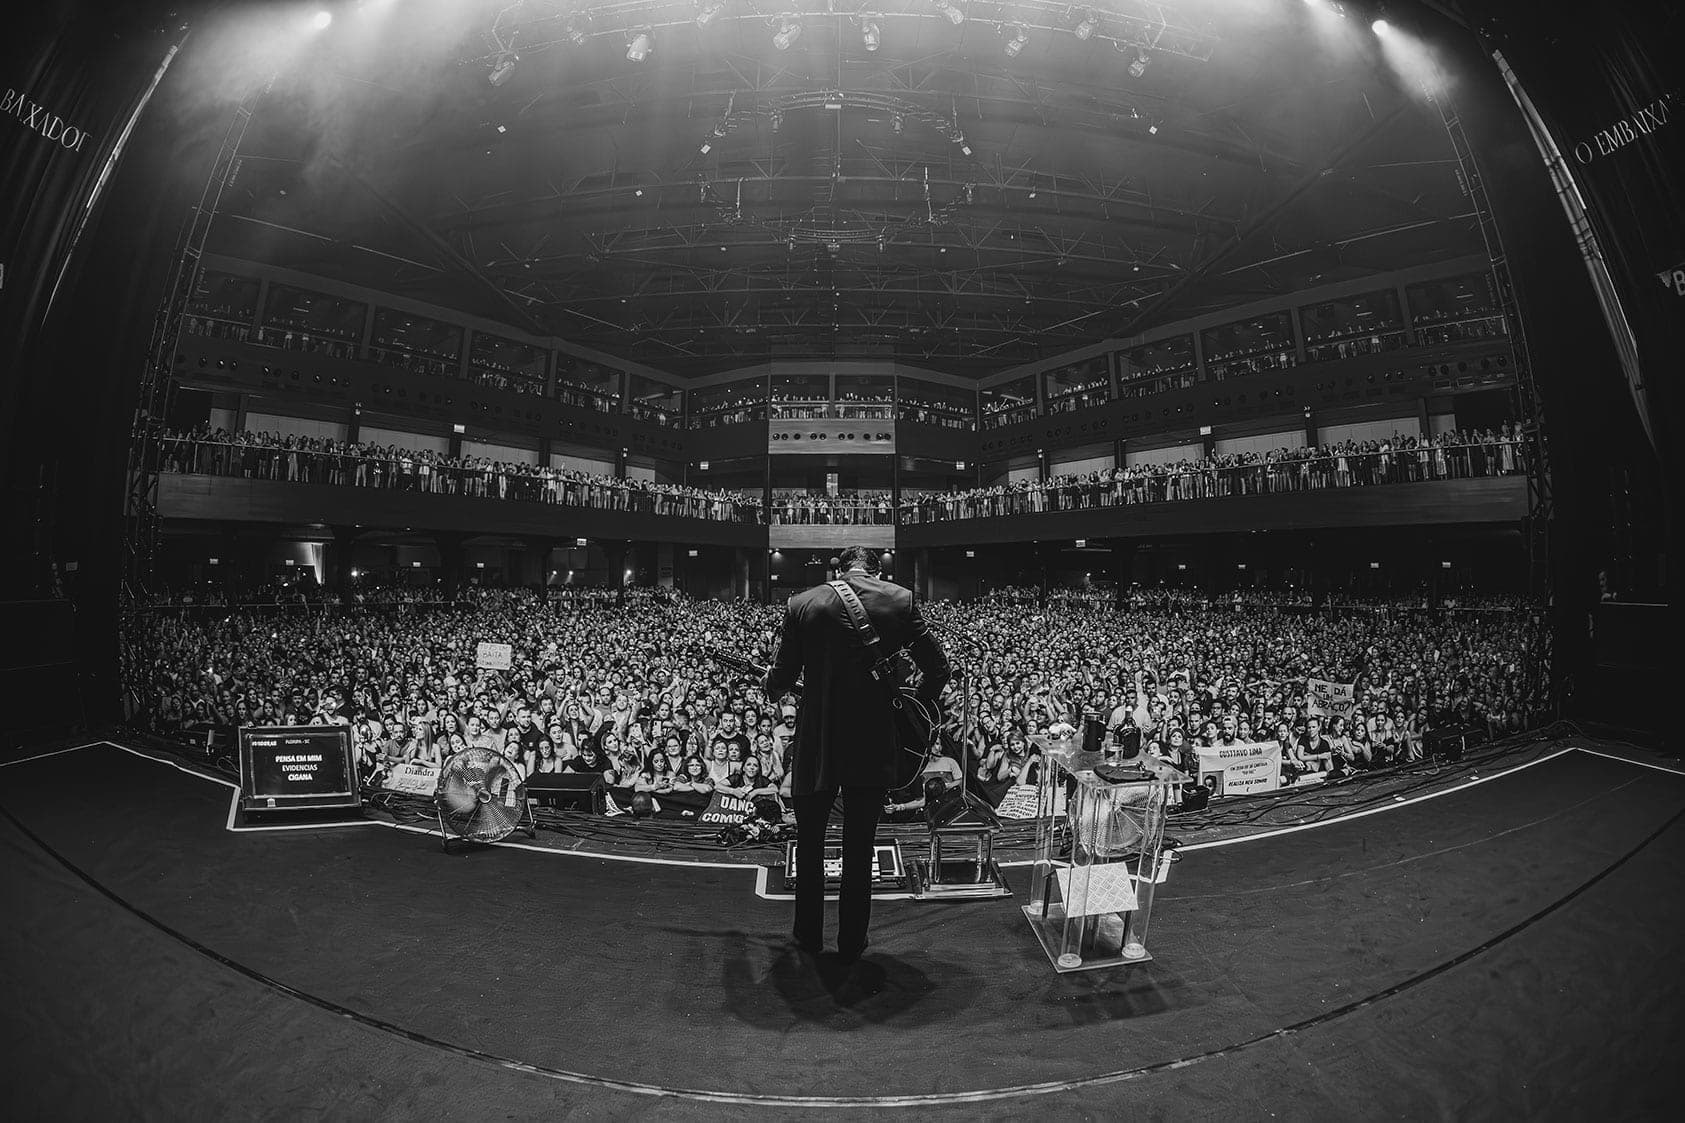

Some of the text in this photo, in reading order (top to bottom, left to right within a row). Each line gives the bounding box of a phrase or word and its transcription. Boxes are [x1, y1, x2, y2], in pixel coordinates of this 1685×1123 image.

[1575, 141, 1593, 164] O
[1334, 686, 1347, 697] DÁ
[275, 754, 322, 763] PENSA EM MIM
[282, 763, 318, 772] EVIDENCIAS
[404, 766, 435, 777] Diandra
[287, 773, 313, 781] CIGANA
[702, 812, 749, 824] COMIG
